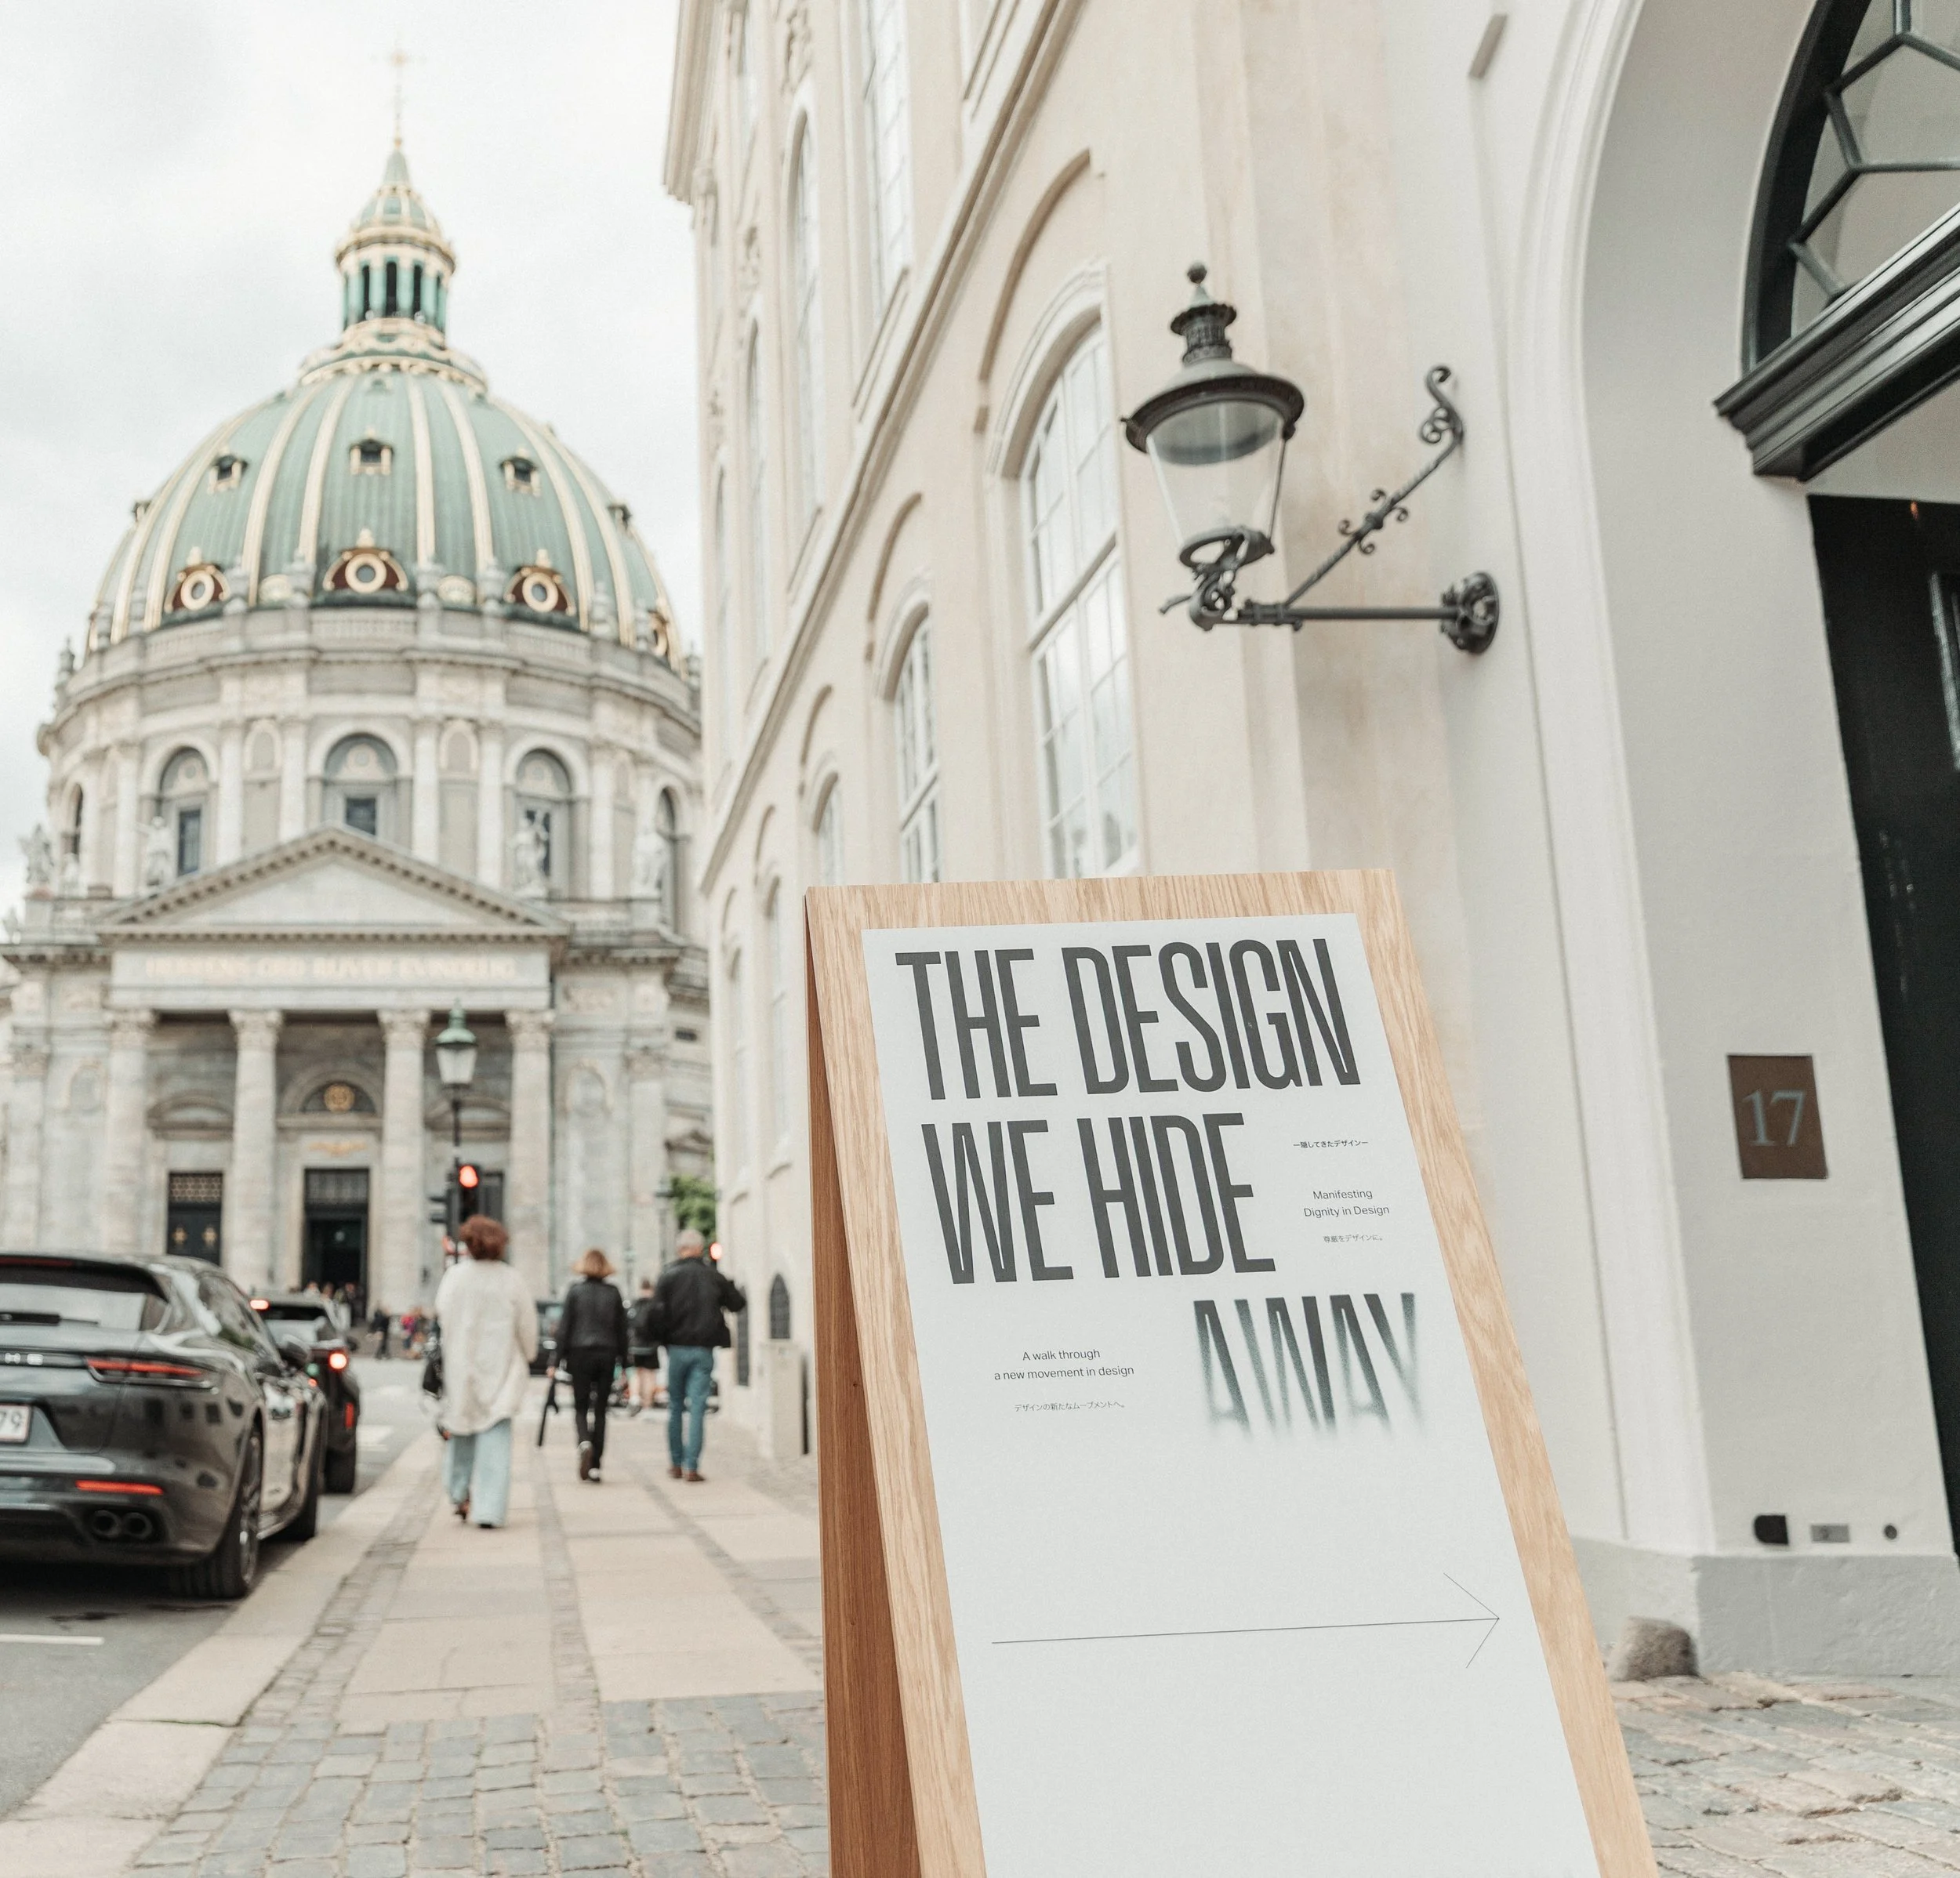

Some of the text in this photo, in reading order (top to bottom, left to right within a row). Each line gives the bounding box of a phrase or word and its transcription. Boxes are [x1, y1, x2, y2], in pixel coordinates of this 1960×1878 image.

[895, 939, 1360, 1100] THE DESIGN
[1742, 1089, 1806, 1147] 17
[921, 1113, 1276, 1284] WE HIDE
[1304, 1205, 1389, 1218] Dignity in Design
[1312, 1190, 1373, 1200] Manifesting
[1004, 1371, 1024, 1379] new
[1027, 1368, 1084, 1379] movement
[1086, 1367, 1096, 1376] in
[1098, 1365, 1134, 1377] design
[1022, 1349, 1101, 1361] A walk through
[1193, 1292, 1423, 1439] AWAY
